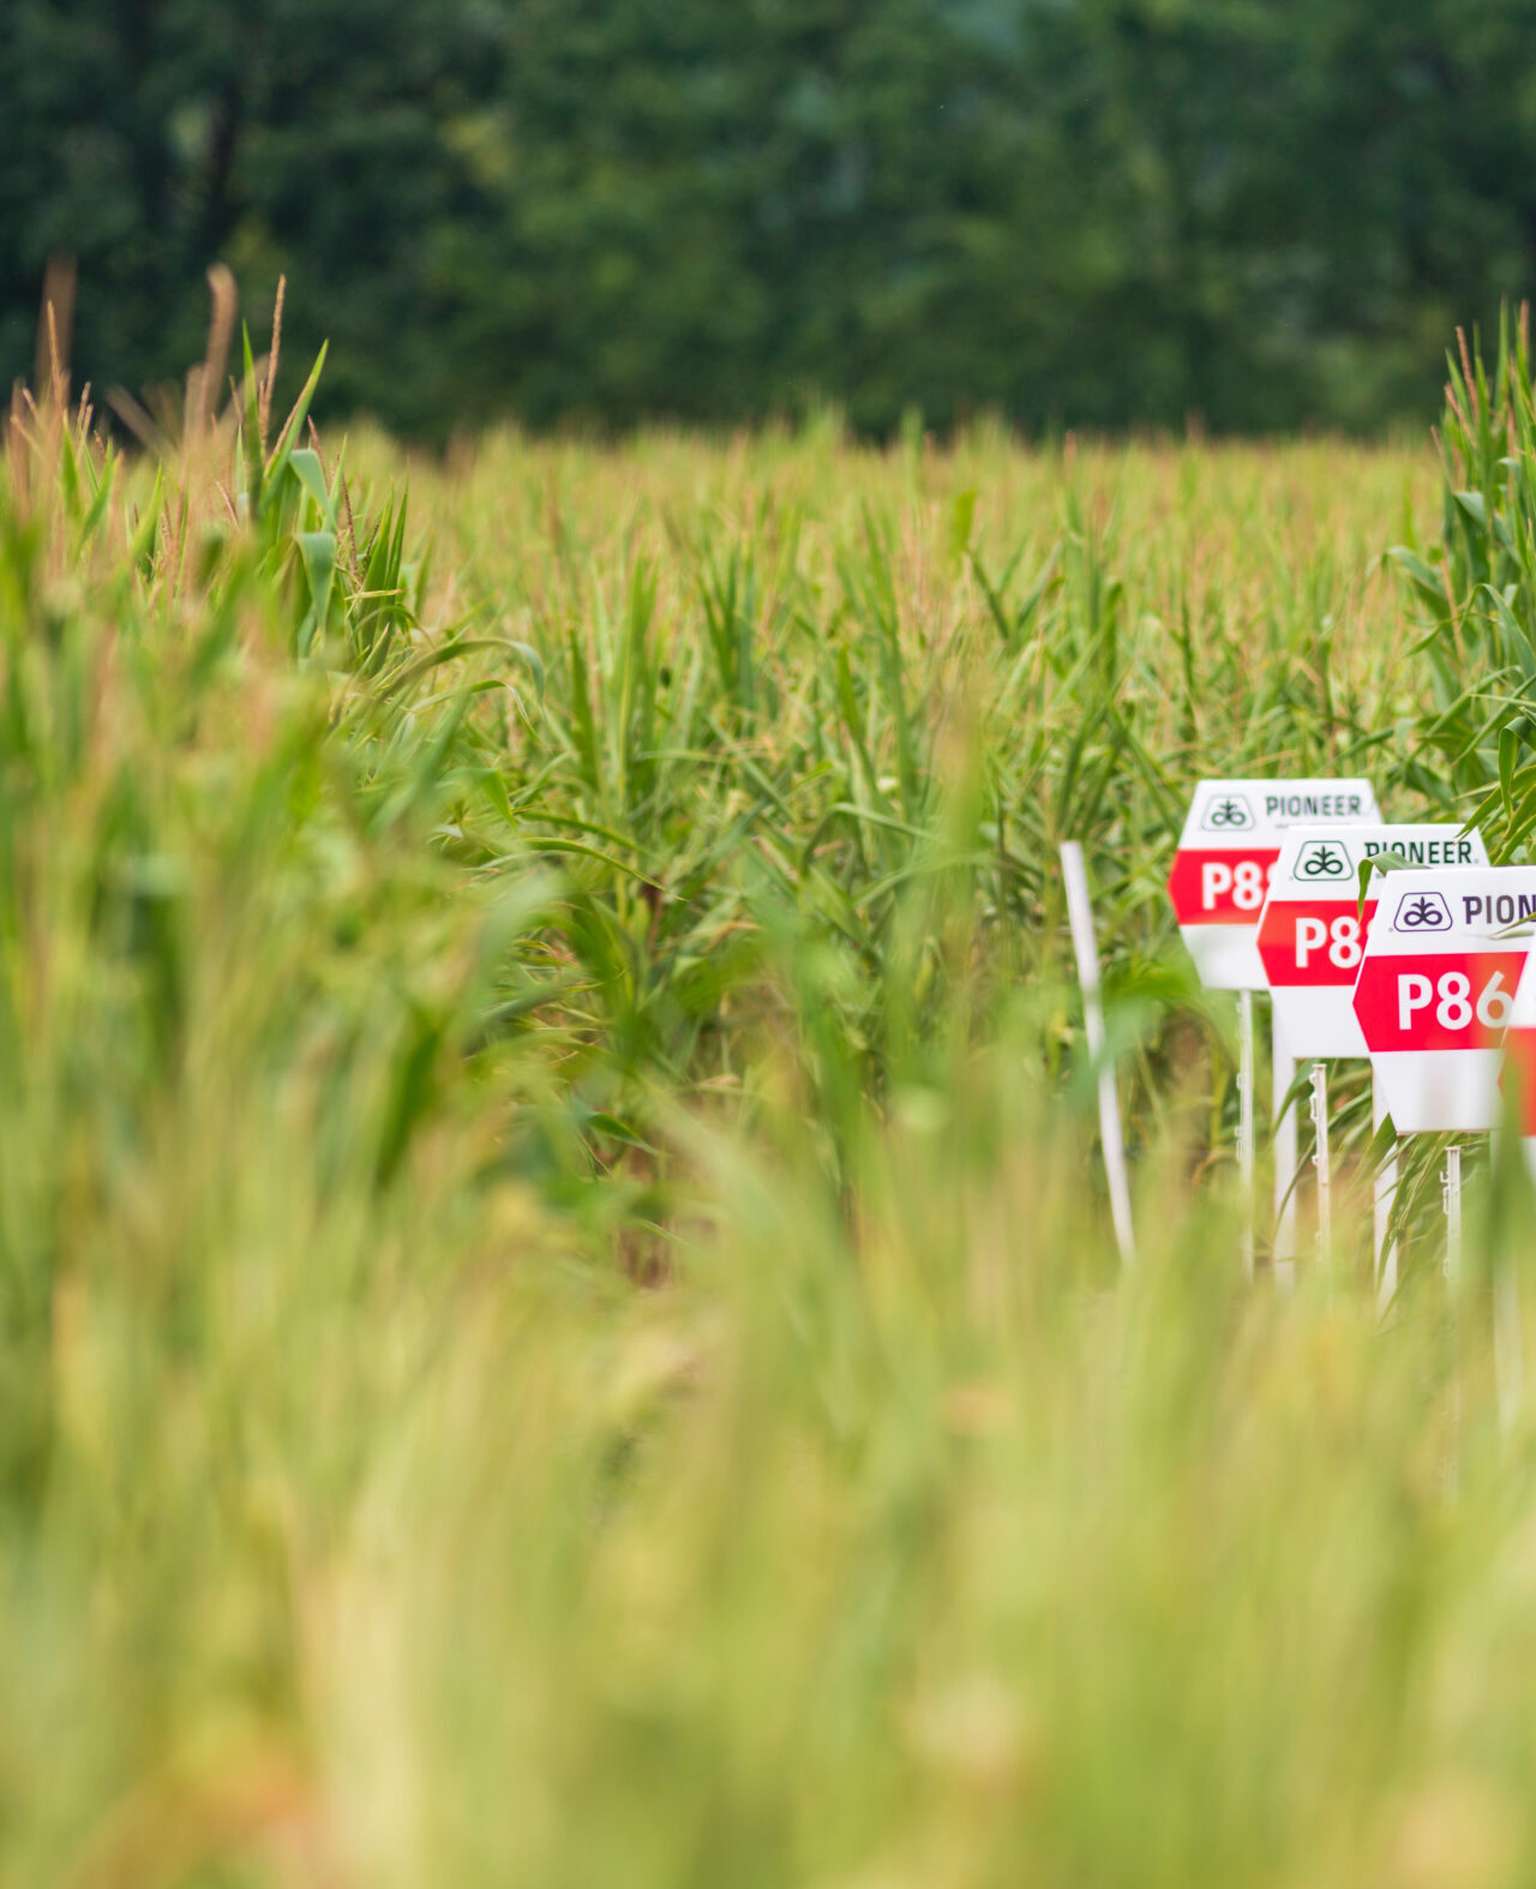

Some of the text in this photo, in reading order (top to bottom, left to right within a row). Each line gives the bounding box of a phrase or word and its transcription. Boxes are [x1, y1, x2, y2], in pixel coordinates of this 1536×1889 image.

[1265, 795, 1361, 817] PIONEER
[1202, 861, 1277, 910] P8
[1295, 916, 1373, 969] P8
[1397, 970, 1514, 1031] P86
